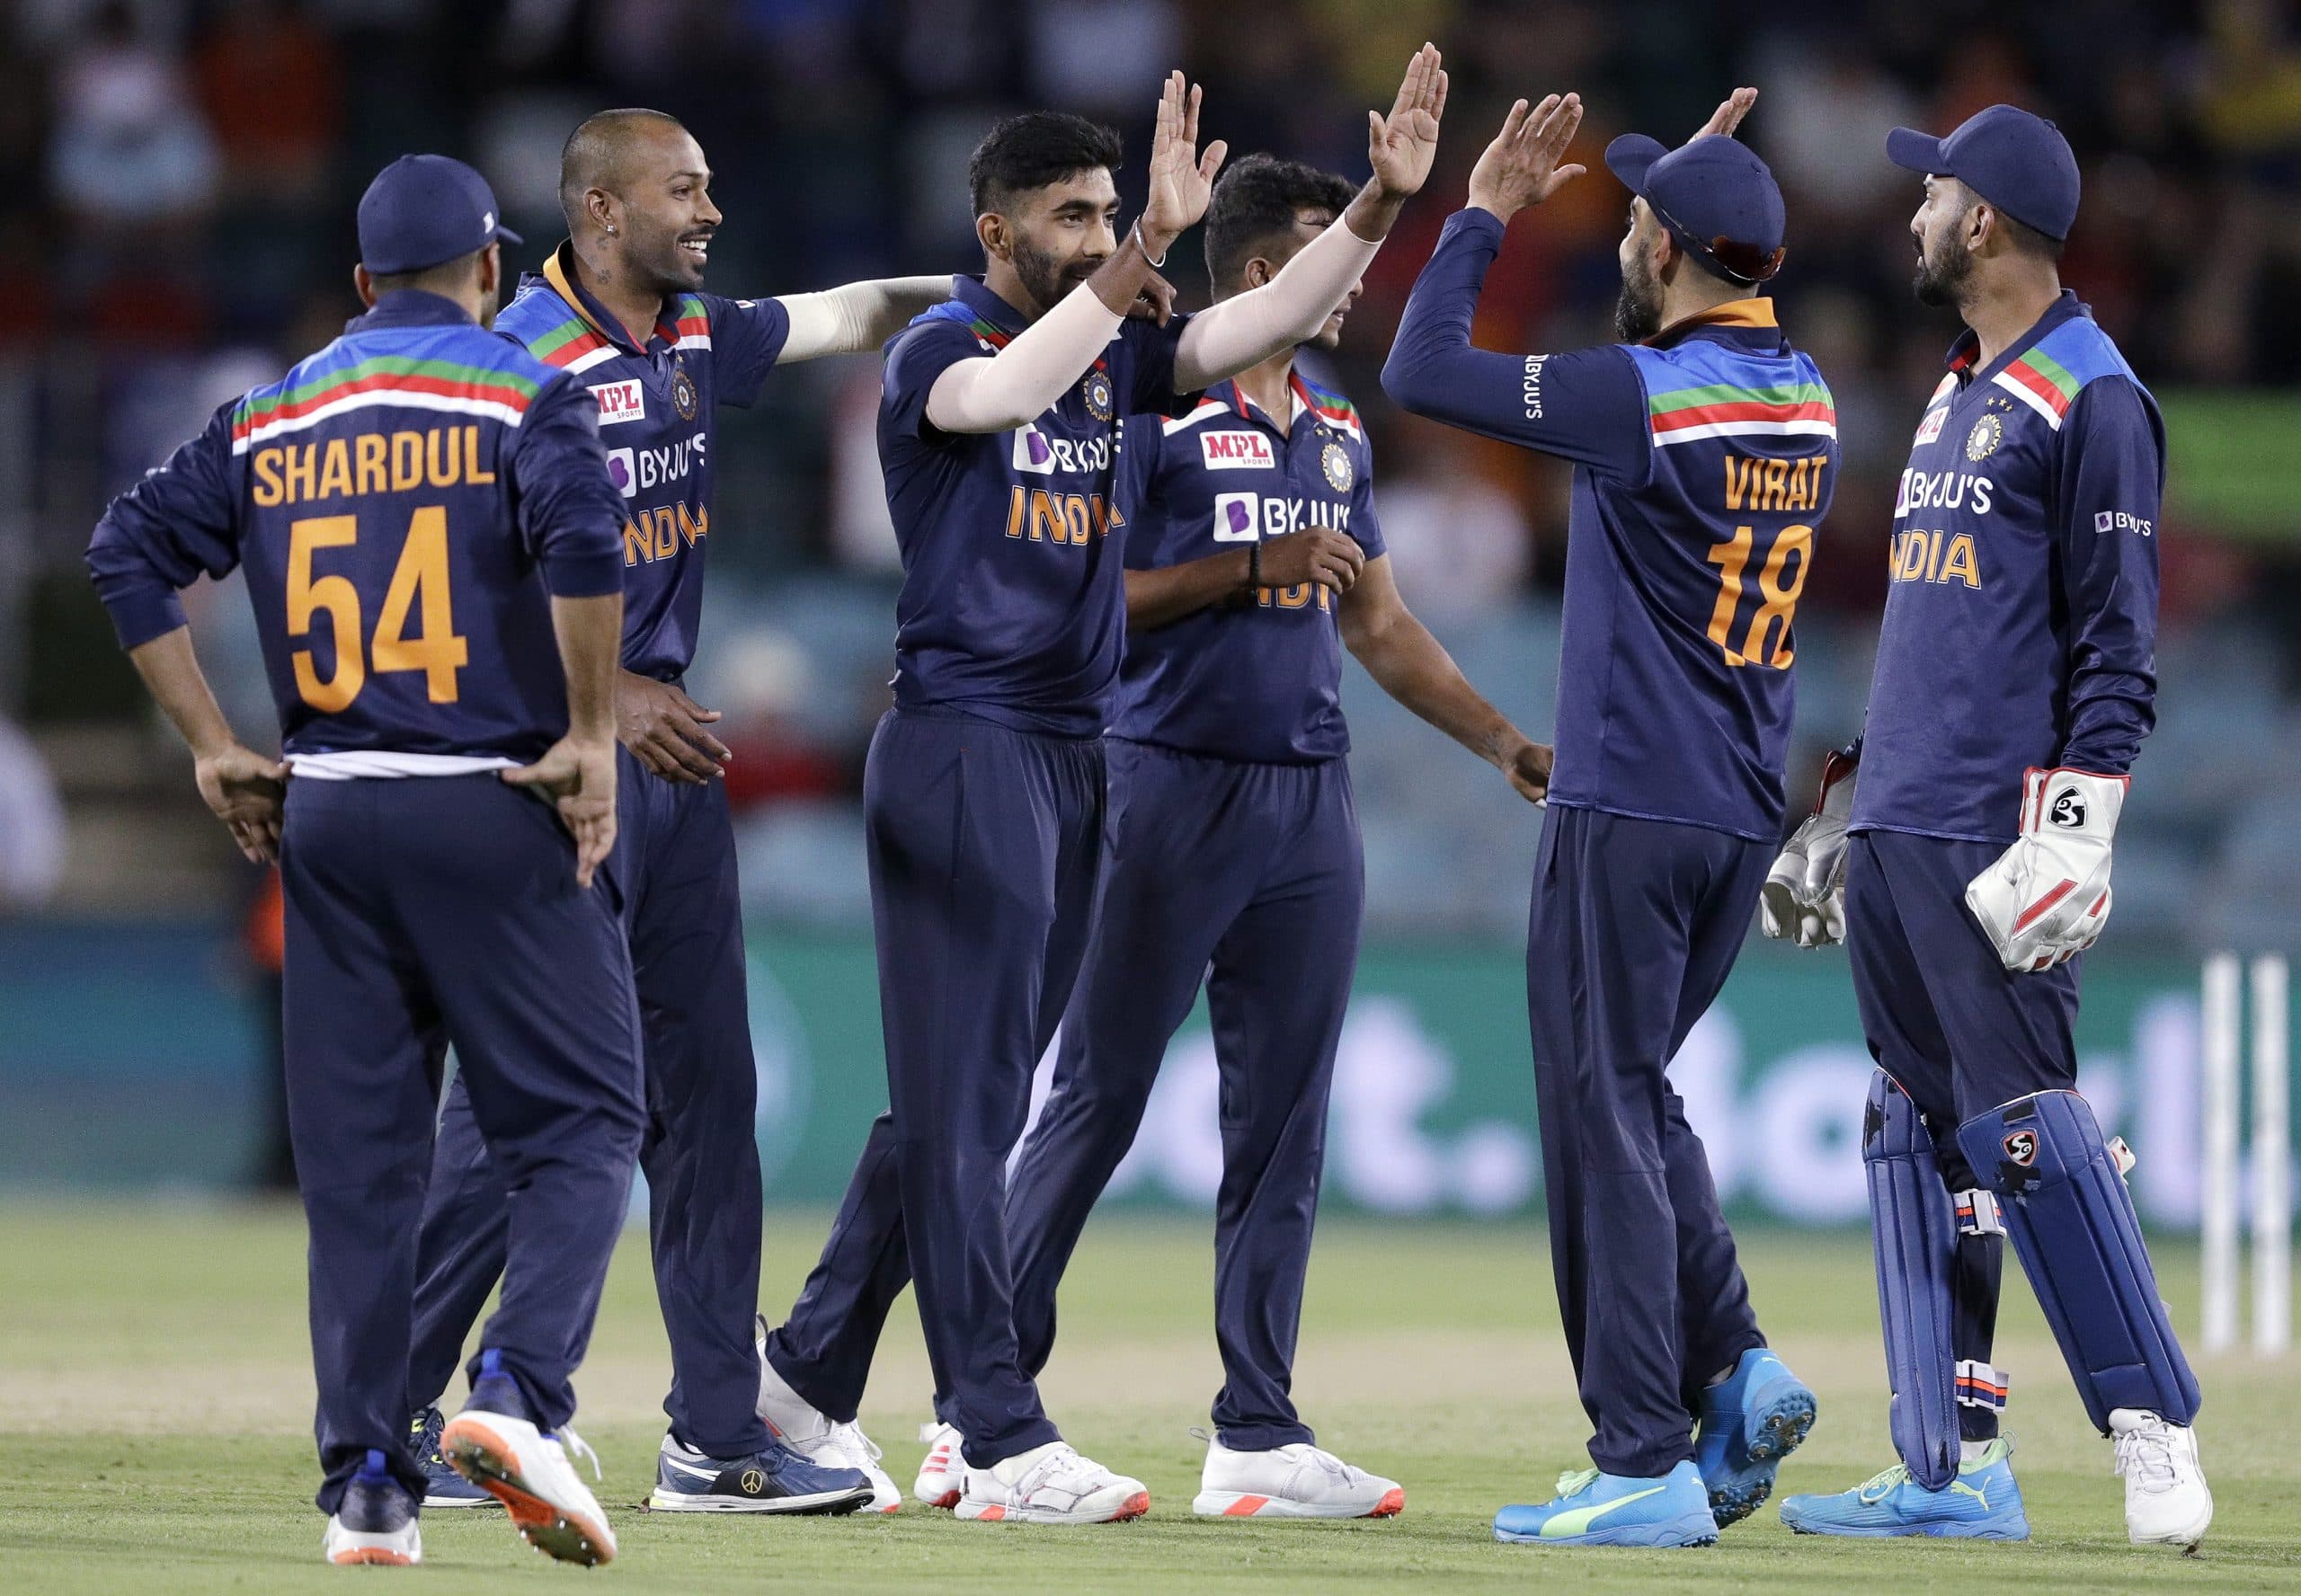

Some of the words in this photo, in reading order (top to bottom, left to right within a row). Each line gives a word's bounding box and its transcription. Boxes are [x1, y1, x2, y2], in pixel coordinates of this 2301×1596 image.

[1523, 362, 1543, 420] BYJU'S
[253, 425, 495, 507] SHARDUL
[1205, 434, 1269, 458] MPL
[1725, 455, 1827, 510] VIRAT
[1909, 471, 1994, 515] BYJU'S
[622, 500, 709, 568] NDIA
[286, 505, 468, 713] 54
[1707, 525, 1813, 670] 18
